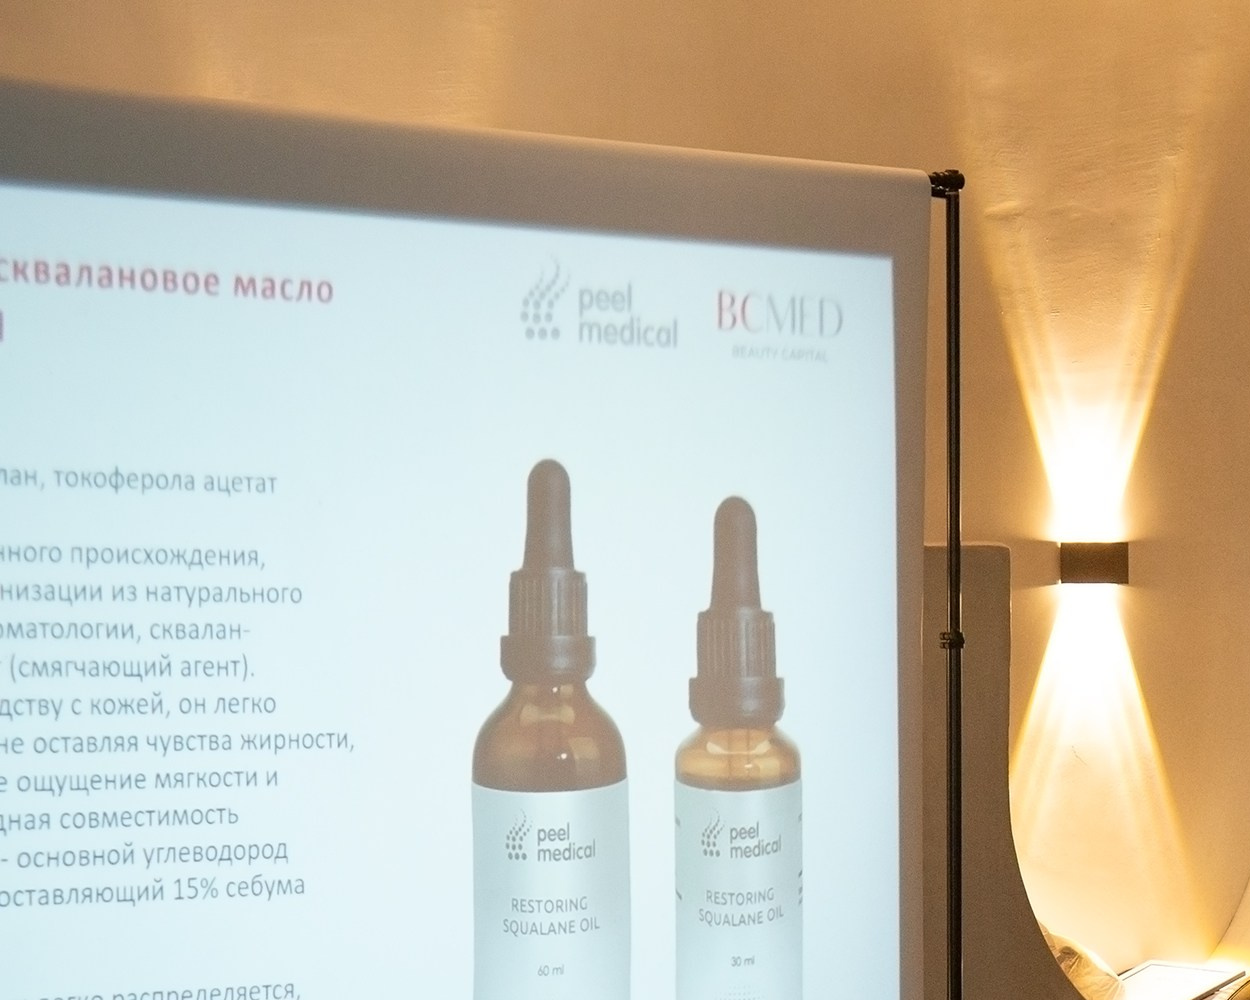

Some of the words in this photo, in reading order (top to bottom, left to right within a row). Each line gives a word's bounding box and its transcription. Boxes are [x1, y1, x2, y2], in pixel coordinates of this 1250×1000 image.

[233, 274, 334, 304] масло
[578, 281, 632, 318] peel
[717, 289, 845, 336] BCMED
[578, 316, 678, 349] medical
[52, 465, 196, 495] токоферола
[203, 474, 278, 497] ацетат
[70, 545, 265, 571] происхождения,
[111, 584, 138, 602] из
[145, 585, 303, 609] натурального
[0, 621, 142, 644] матологии,
[149, 621, 251, 641] сквалан-
[9, 653, 172, 684] (смягчающий
[180, 653, 255, 682] агент).
[70, 697, 82, 716] с
[90, 691, 171, 719] кожей,
[178, 697, 206, 715] он
[213, 696, 277, 715] легко
[32, 735, 139, 755] оставляя
[145, 733, 233, 758] чувства
[240, 732, 355, 756] жирности,
[16, 772, 147, 797] ощущение
[154, 770, 258, 789] мягкости
[266, 770, 278, 787] и
[59, 807, 239, 830] совместимость
[537, 822, 570, 846] peel
[729, 821, 760, 845] peel
[16, 841, 135, 869] основной
[142, 842, 289, 870] углеводород
[537, 838, 596, 862] medical
[729, 834, 782, 859] medical
[173, 876, 219, 901] 15%
[225, 873, 305, 902] себума
[705, 886, 775, 907] RESTORING
[511, 896, 588, 914] RESTORING
[698, 907, 764, 928] SQUALANE
[766, 903, 785, 922] OIL
[502, 917, 576, 939] SQUALANE
[579, 916, 601, 933] OIL
[537, 964, 550, 978] 60
[551, 964, 565, 976] ml
[731, 955, 743, 968] 30
